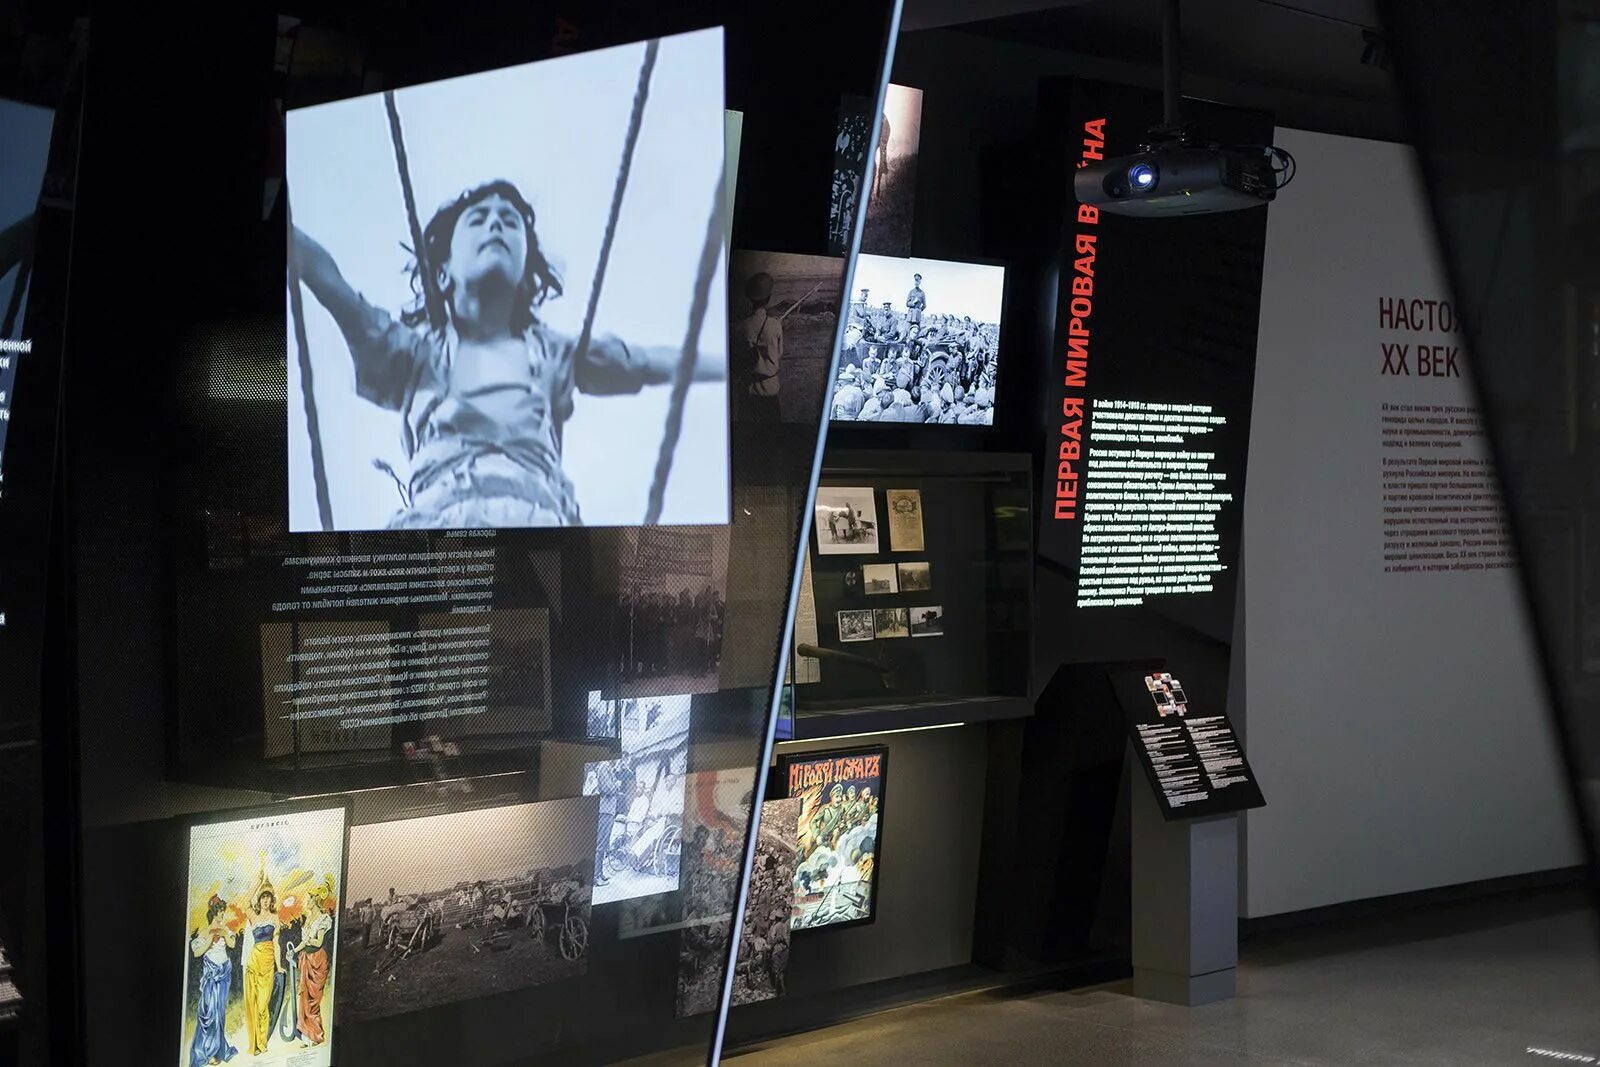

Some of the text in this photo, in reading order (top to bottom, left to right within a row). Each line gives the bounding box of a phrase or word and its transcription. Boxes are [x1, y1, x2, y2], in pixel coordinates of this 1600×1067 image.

[1055, 118, 1106, 519] ПЕРВАЯ МИРОВАЯ ВНА
[1418, 345, 1461, 378] ВЕК
